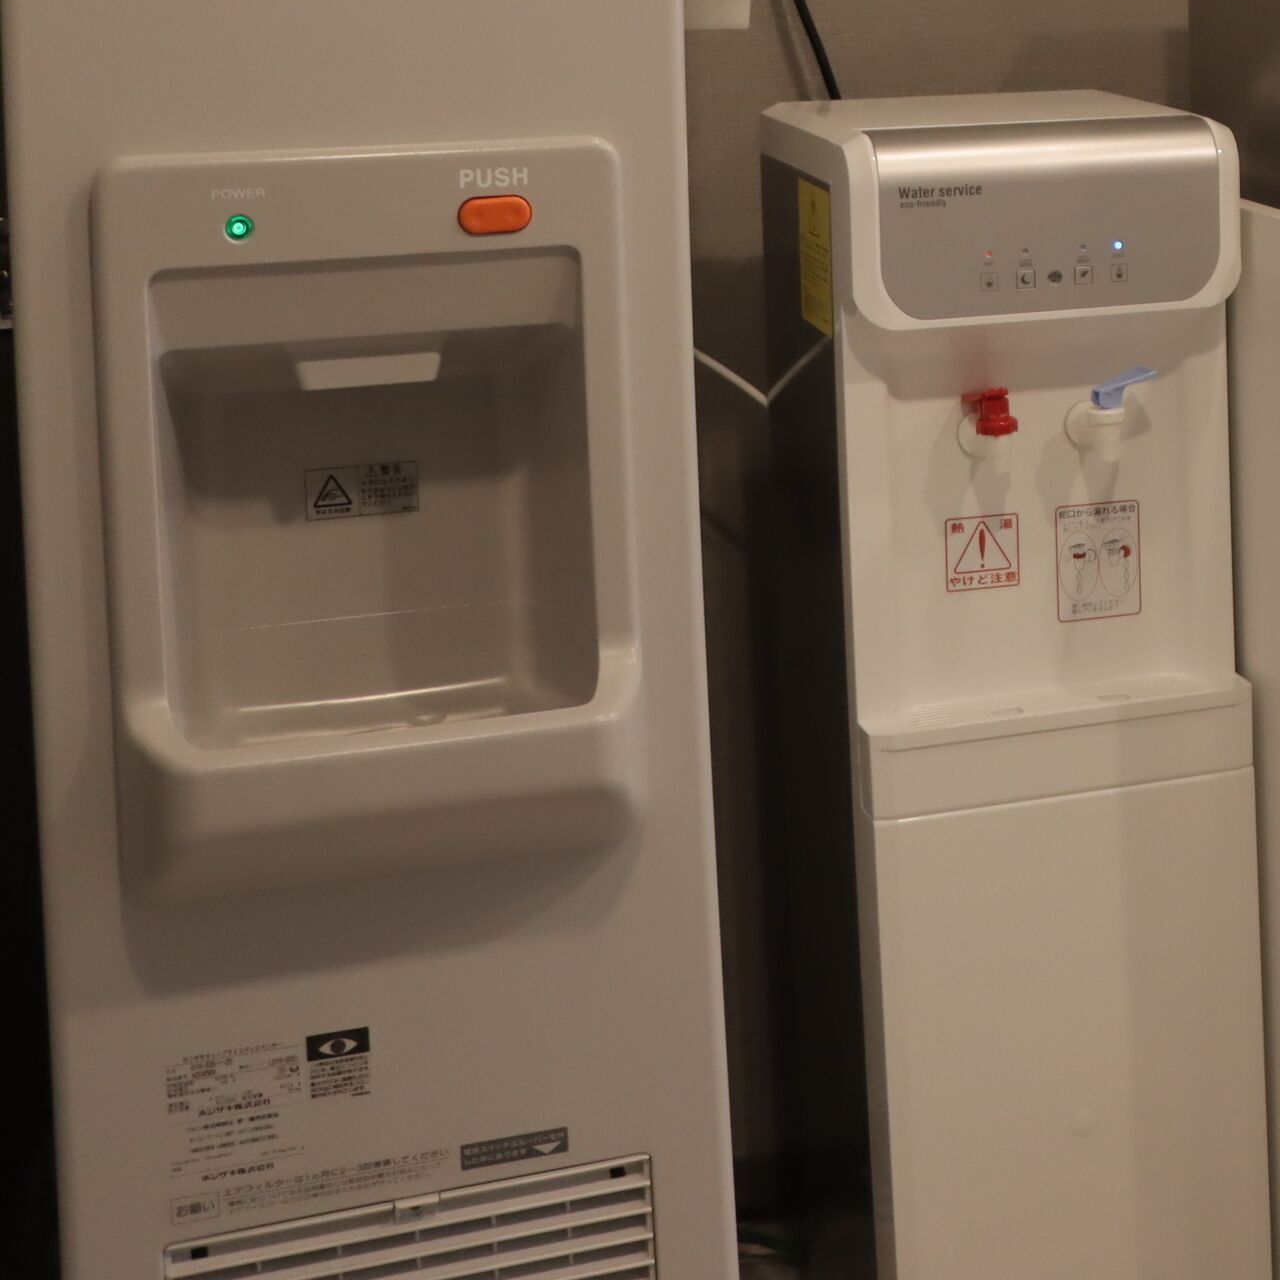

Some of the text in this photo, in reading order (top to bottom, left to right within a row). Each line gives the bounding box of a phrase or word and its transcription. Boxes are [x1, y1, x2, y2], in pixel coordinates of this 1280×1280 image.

[459, 167, 529, 189] PUSH
[211, 187, 266, 200] POWER
[898, 182, 983, 200] Water service
[899, 199, 947, 210] eco-friendly
[950, 571, 1018, 587] やけど注意
